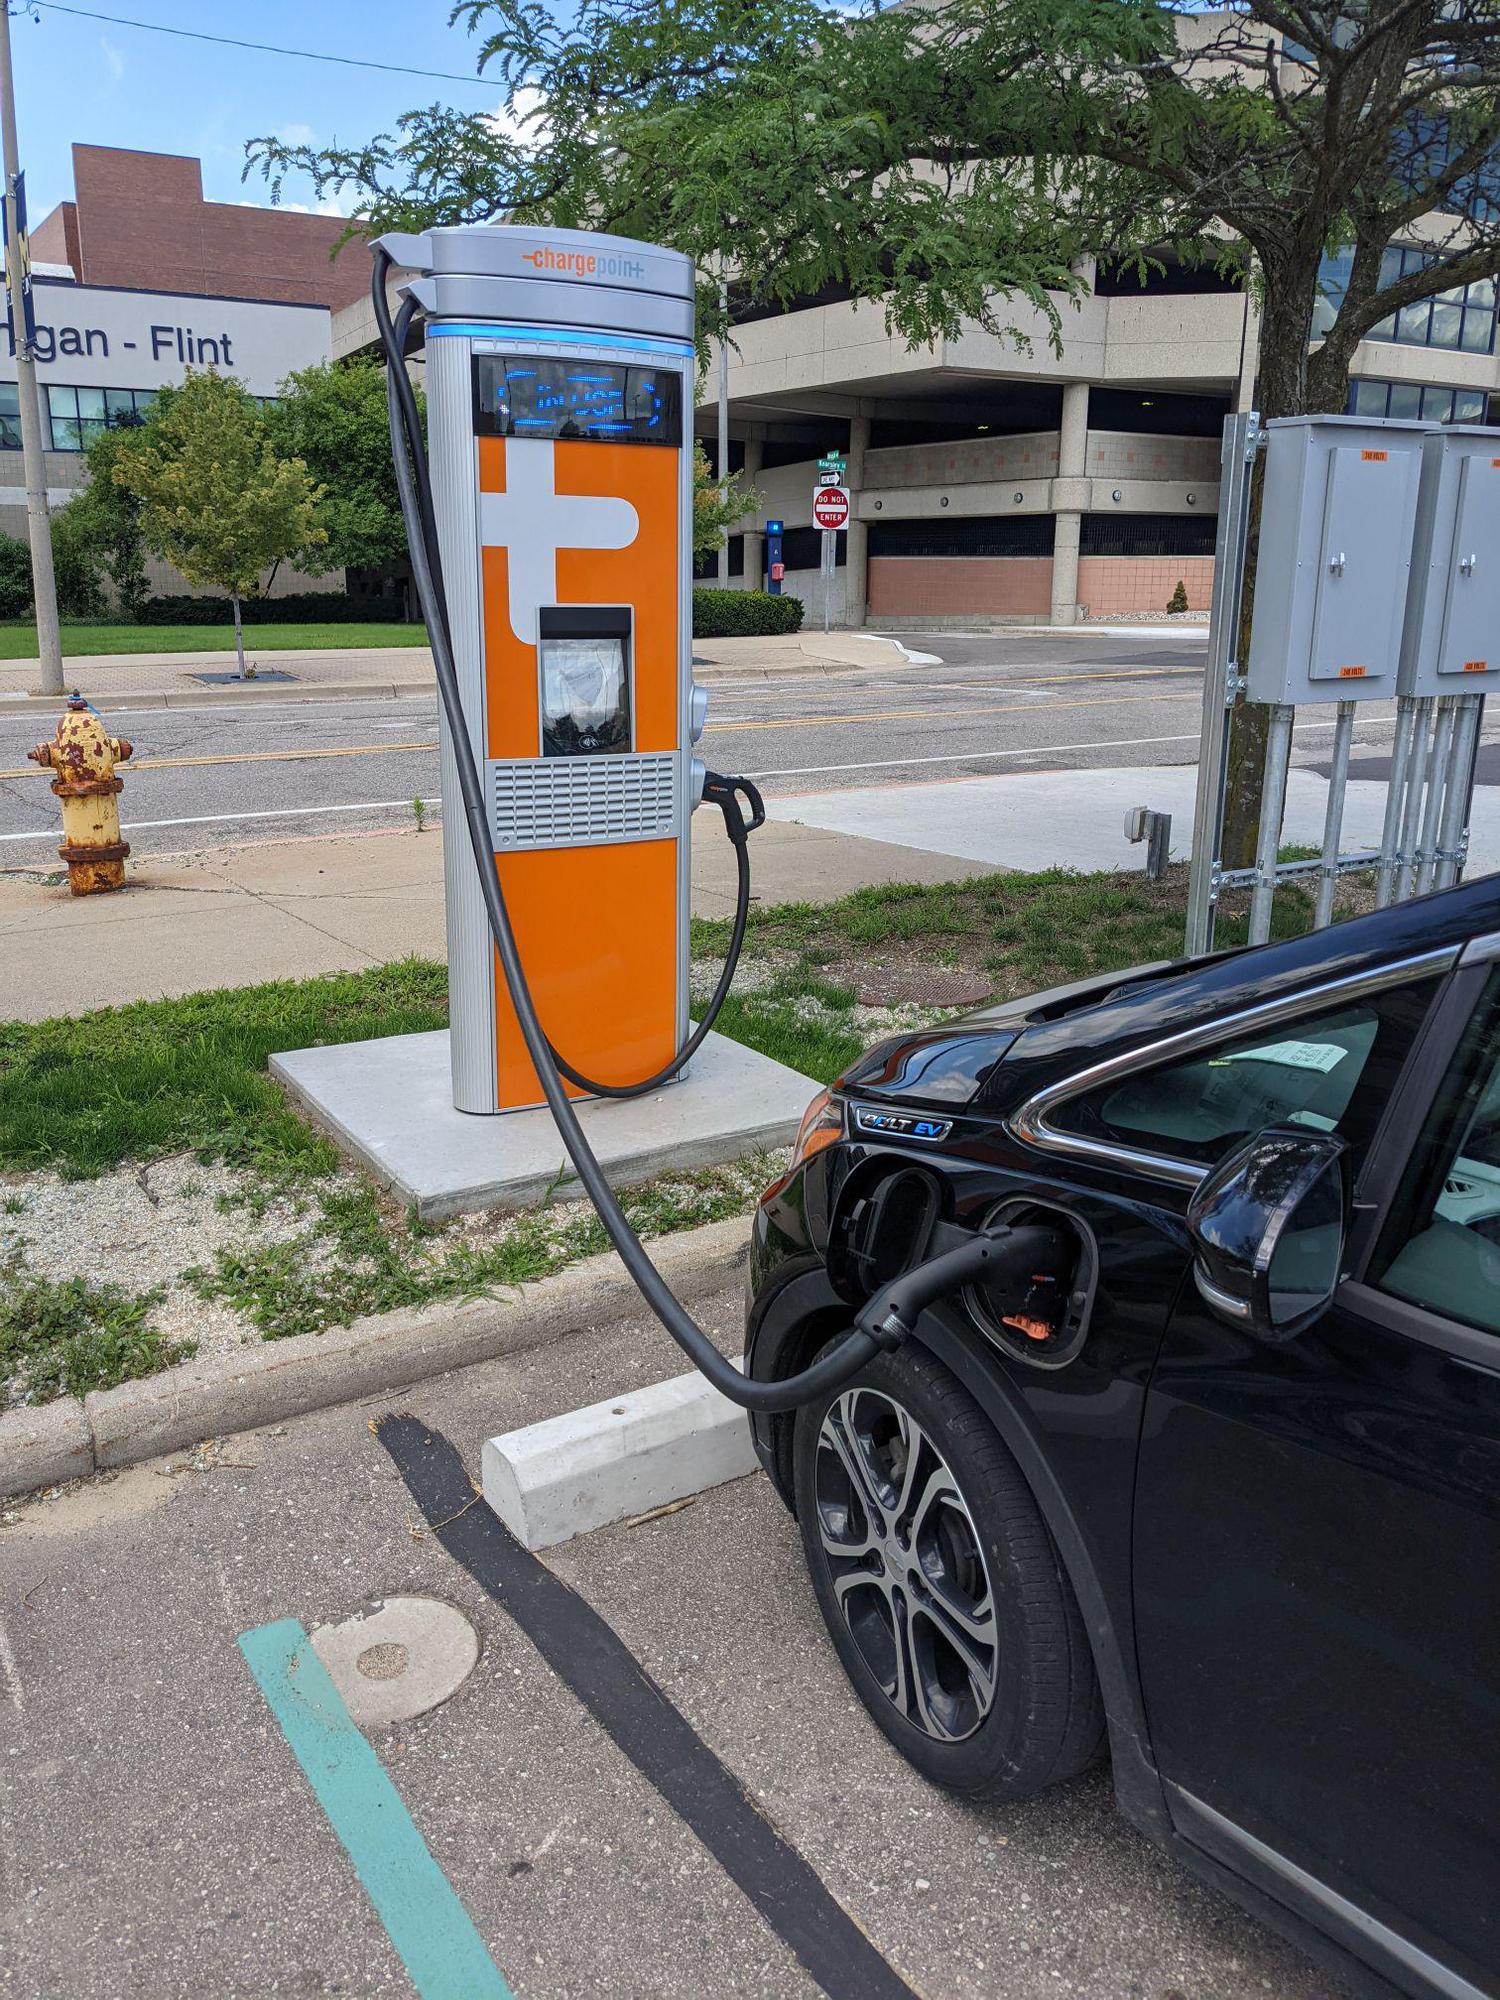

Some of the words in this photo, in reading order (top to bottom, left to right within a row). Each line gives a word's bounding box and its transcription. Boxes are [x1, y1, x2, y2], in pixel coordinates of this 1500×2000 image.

[522, 247, 645, 278] chargepoint
[0, 320, 108, 363] gan
[150, 324, 234, 367] Flint
[820, 513, 842, 521] ENTER
[862, 1113, 912, 1131] BOLT
[914, 1122, 943, 1136] EV
